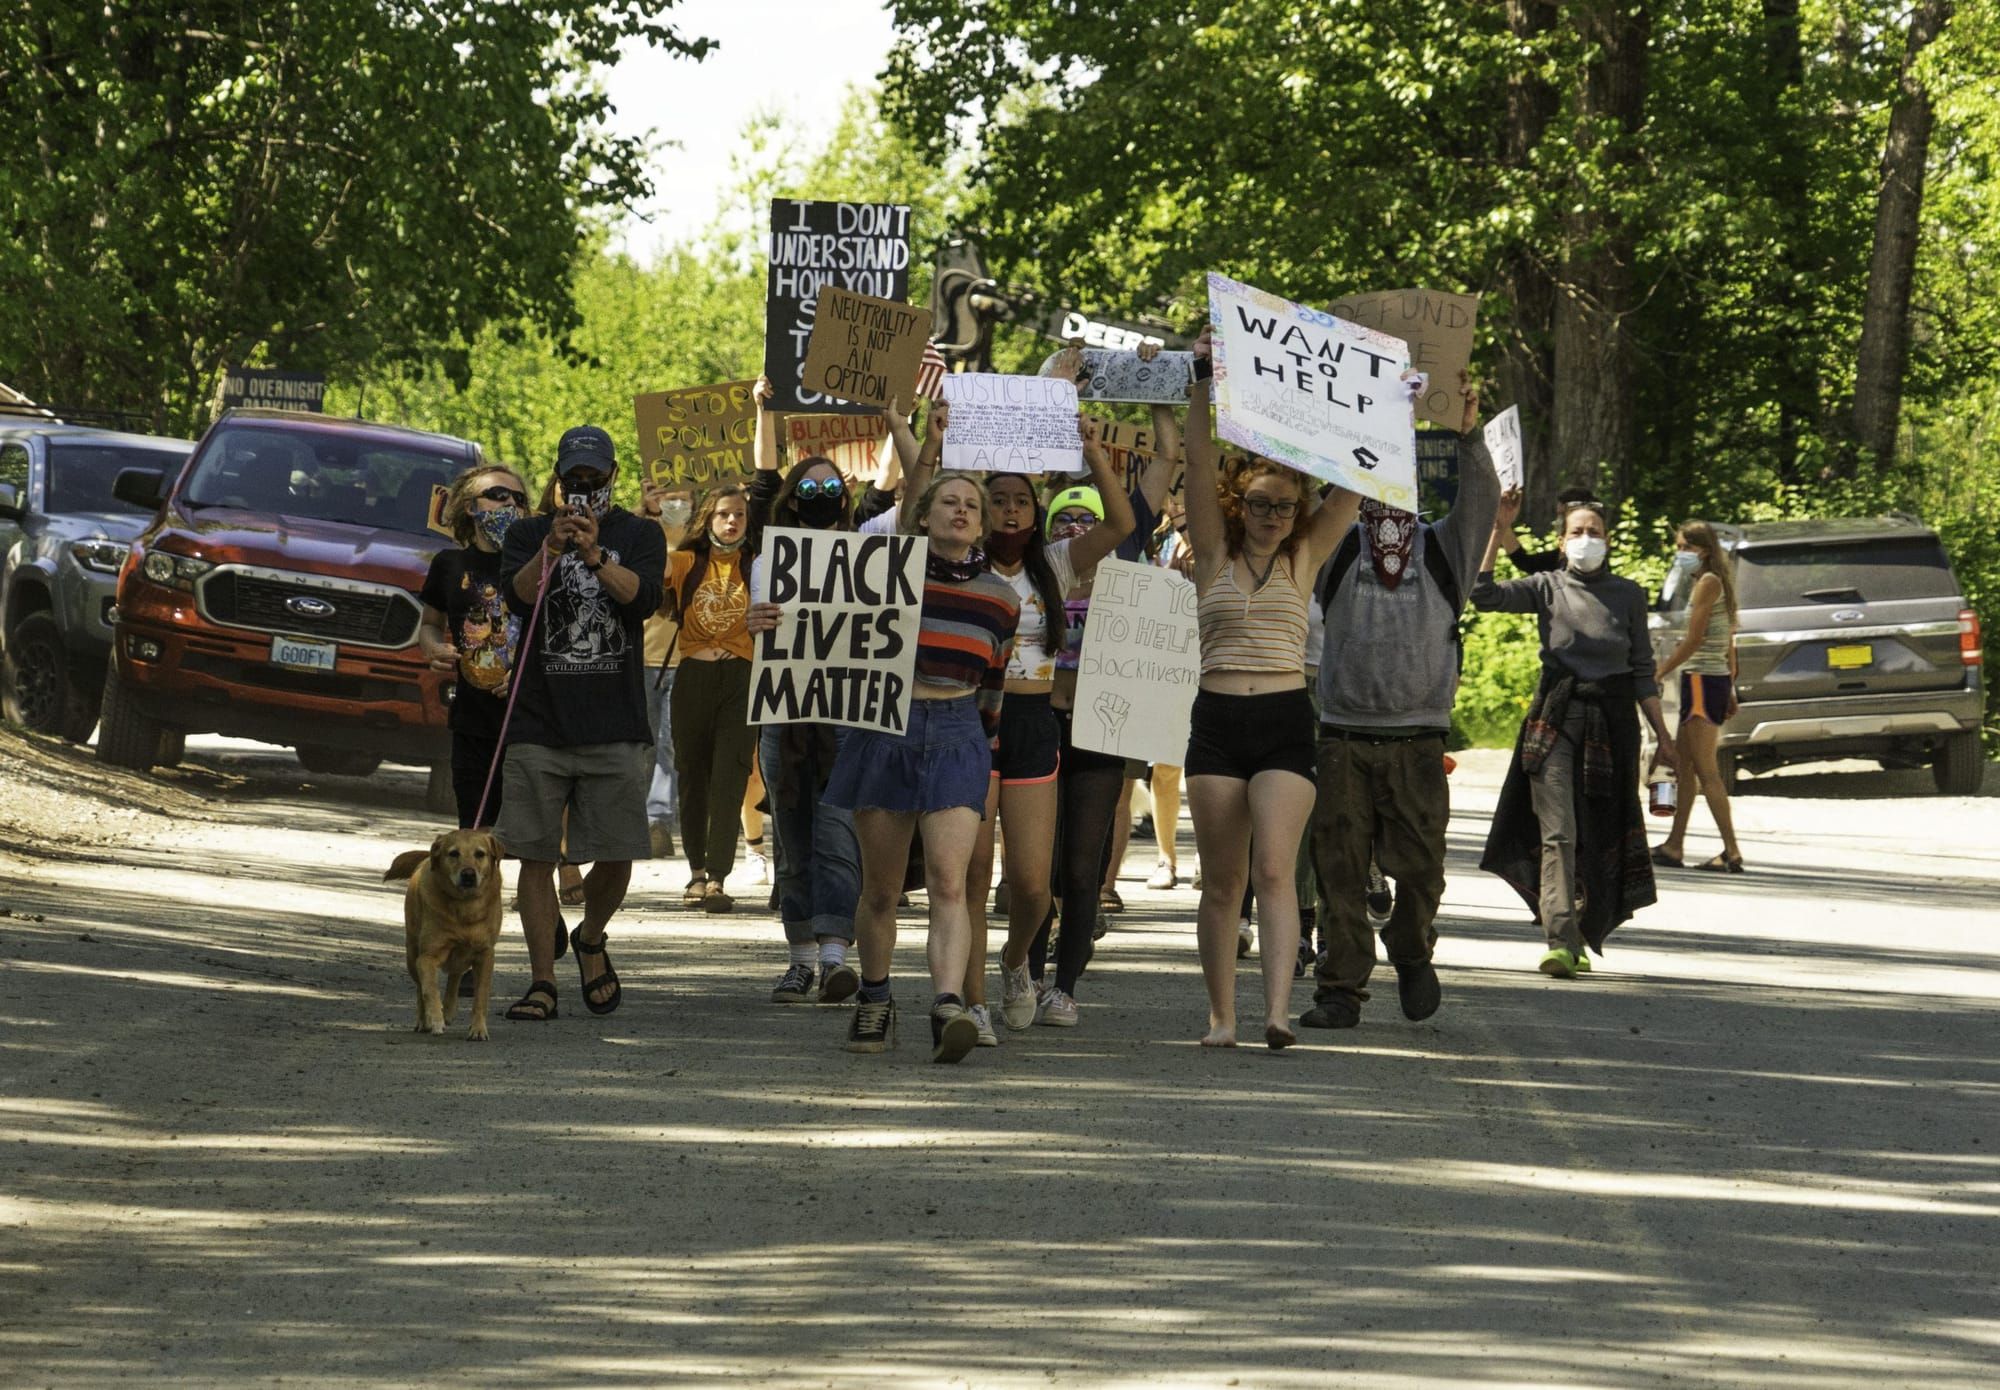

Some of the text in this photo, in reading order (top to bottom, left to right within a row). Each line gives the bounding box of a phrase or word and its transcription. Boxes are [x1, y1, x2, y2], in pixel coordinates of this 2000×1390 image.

[789, 200, 814, 231] I
[769, 232, 910, 270] UNDERSTAND
[776, 268, 894, 299] HOW YOU
[830, 294, 918, 336] NEUTRALITY
[848, 325, 896, 352] IS NOT
[1236, 305, 1397, 378] WANT
[848, 350, 873, 372] AN
[1285, 350, 1338, 378] TO
[225, 376, 324, 400] NO OVERNIGHT
[824, 364, 888, 401] OPTION
[945, 375, 1038, 405] JUSTICE
[1253, 356, 1374, 413] HELP
[665, 386, 750, 422] STOP
[791, 415, 888, 440] BLACK LIV
[650, 449, 756, 488] BRUTAL
[972, 447, 1045, 472] ACAB
[243, 569, 387, 595] RANGER
[769, 535, 919, 606] BLACK
[1096, 566, 1200, 617] IF YO
[1092, 608, 1130, 643] TO
[1135, 617, 1199, 654] HELP
[545, 663, 590, 672] CIVILIZED
[750, 666, 904, 731] MATTER
